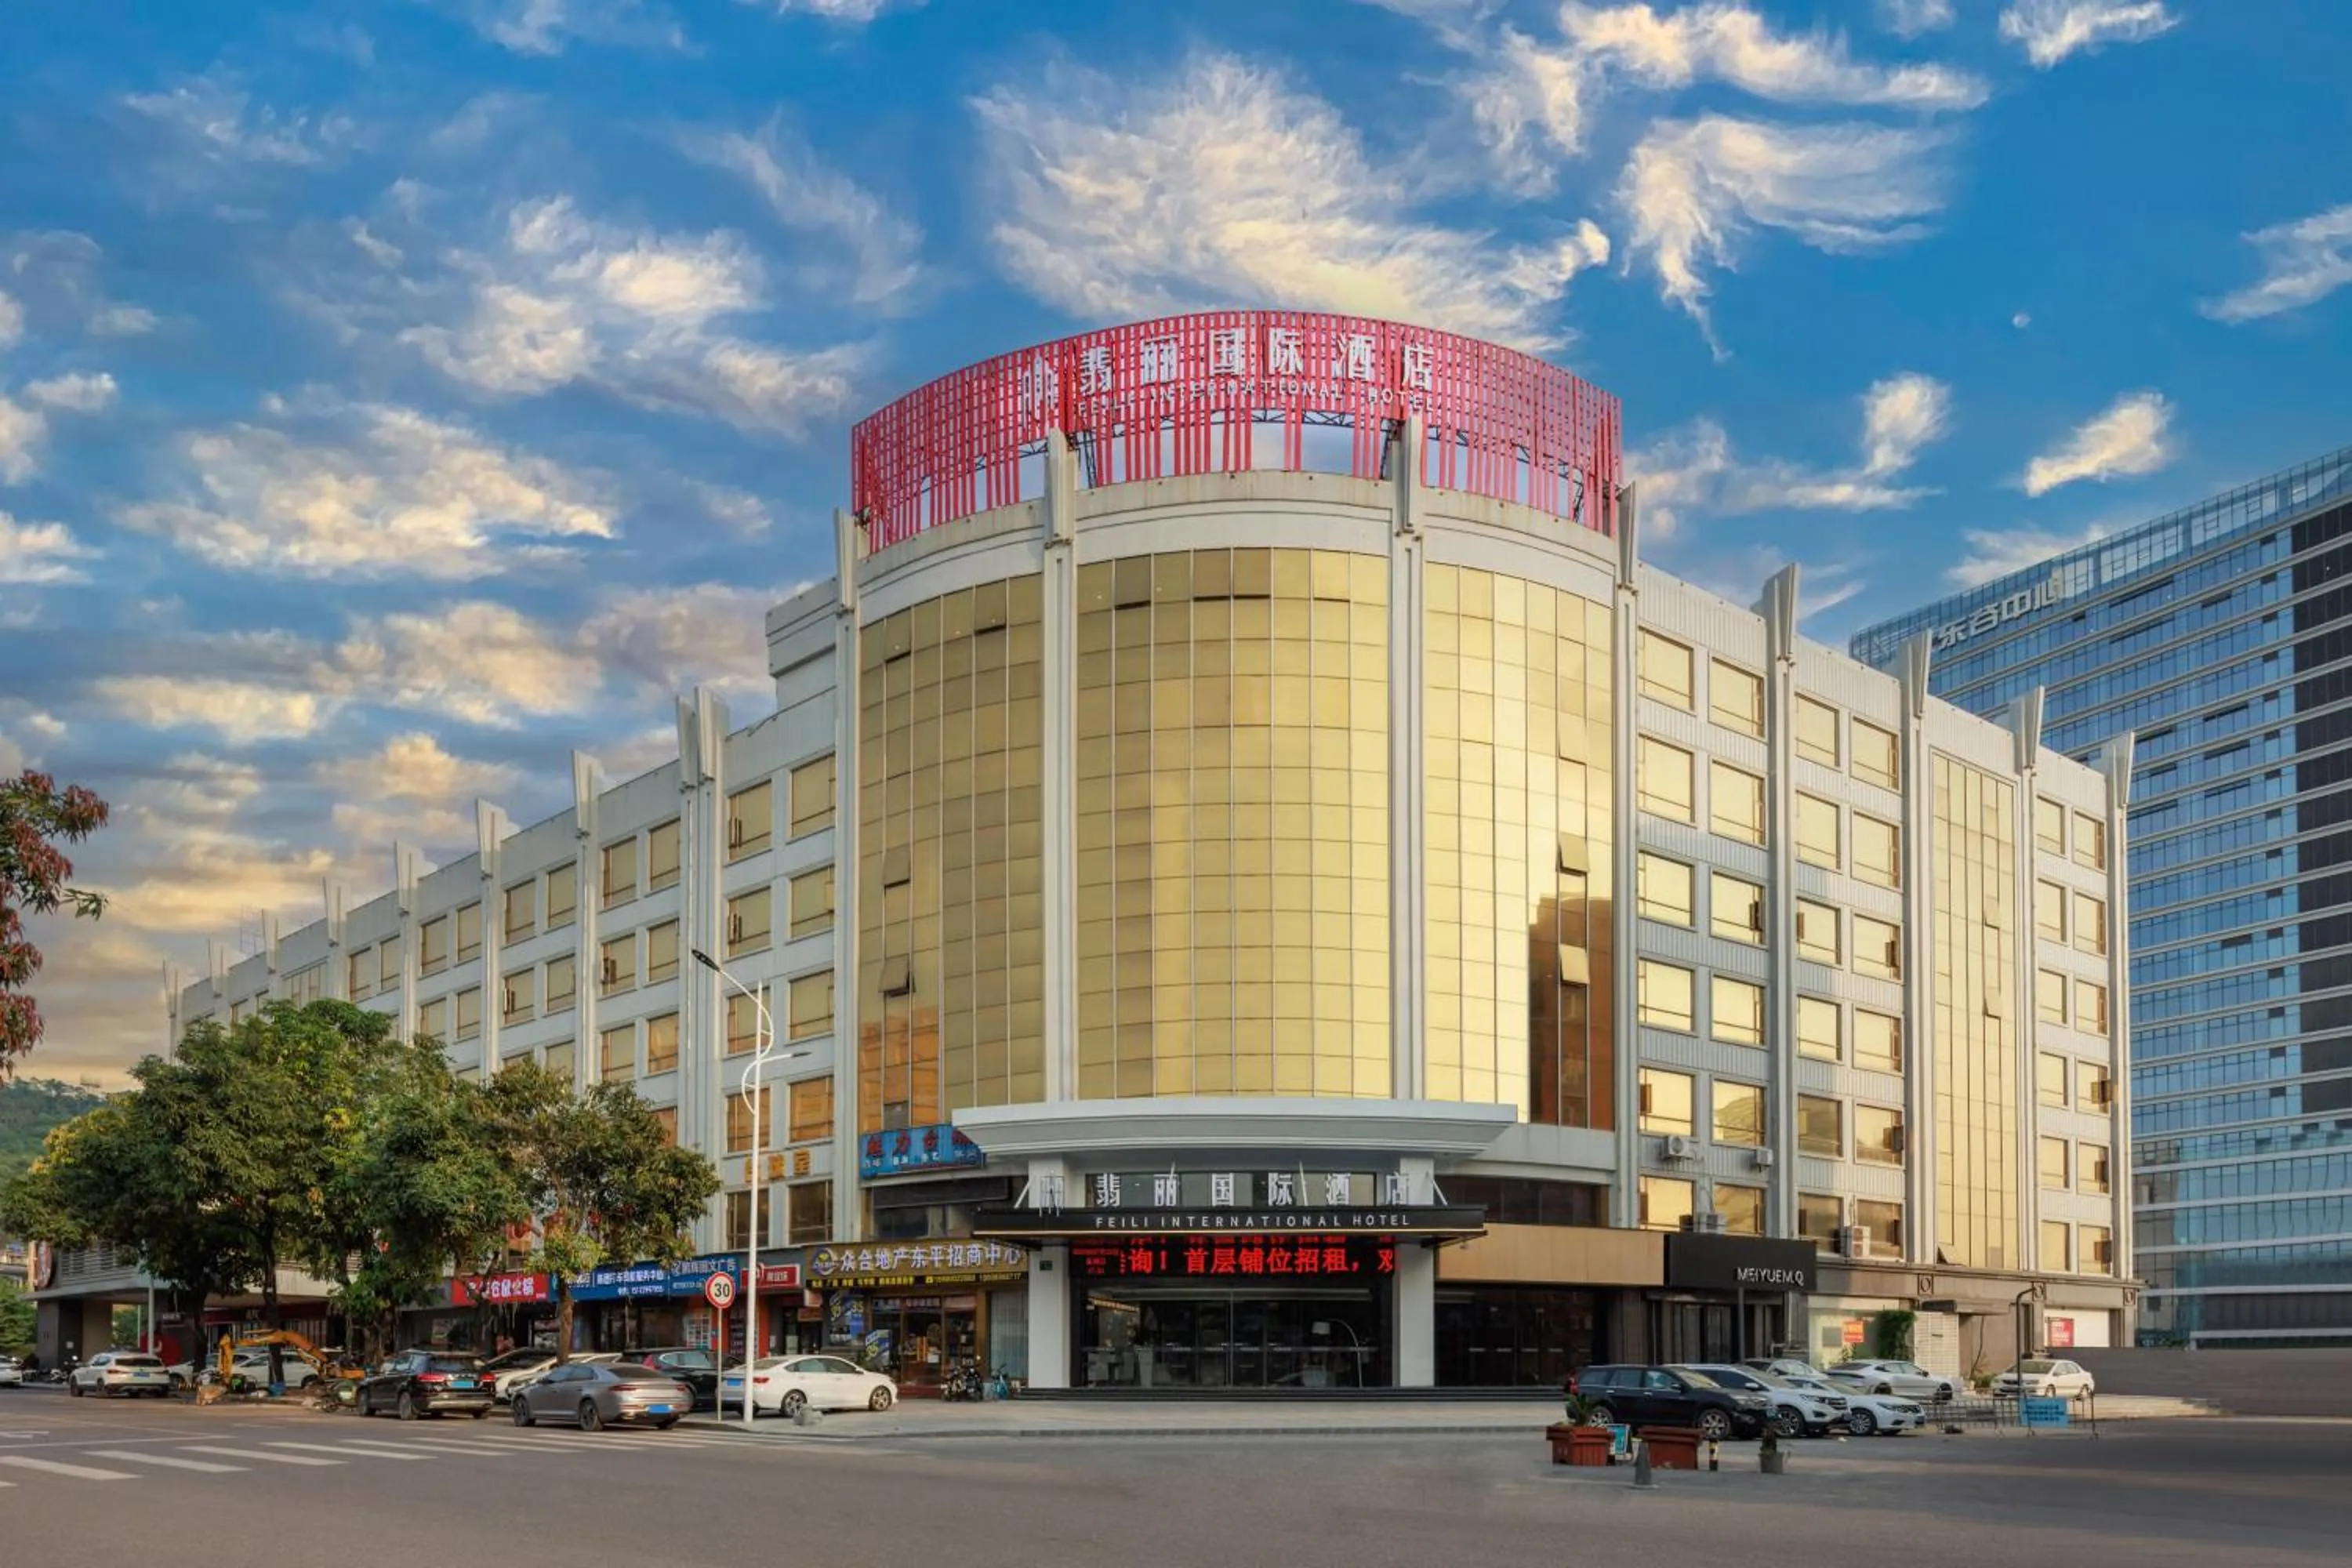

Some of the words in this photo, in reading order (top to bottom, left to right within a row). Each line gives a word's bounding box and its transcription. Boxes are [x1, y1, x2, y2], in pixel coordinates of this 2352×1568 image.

[1079, 328, 1436, 394] 翡丽国际酒店
[1368, 387, 1433, 412] HOTEL
[1096, 1172, 1410, 1207] 翡丽国际酒店
[1096, 1216, 1149, 1229] FEILI
[1160, 1215, 1341, 1228] INTERNATIONAL
[1352, 1214, 1410, 1226] HOTEL
[713, 1283, 730, 1298] 30
